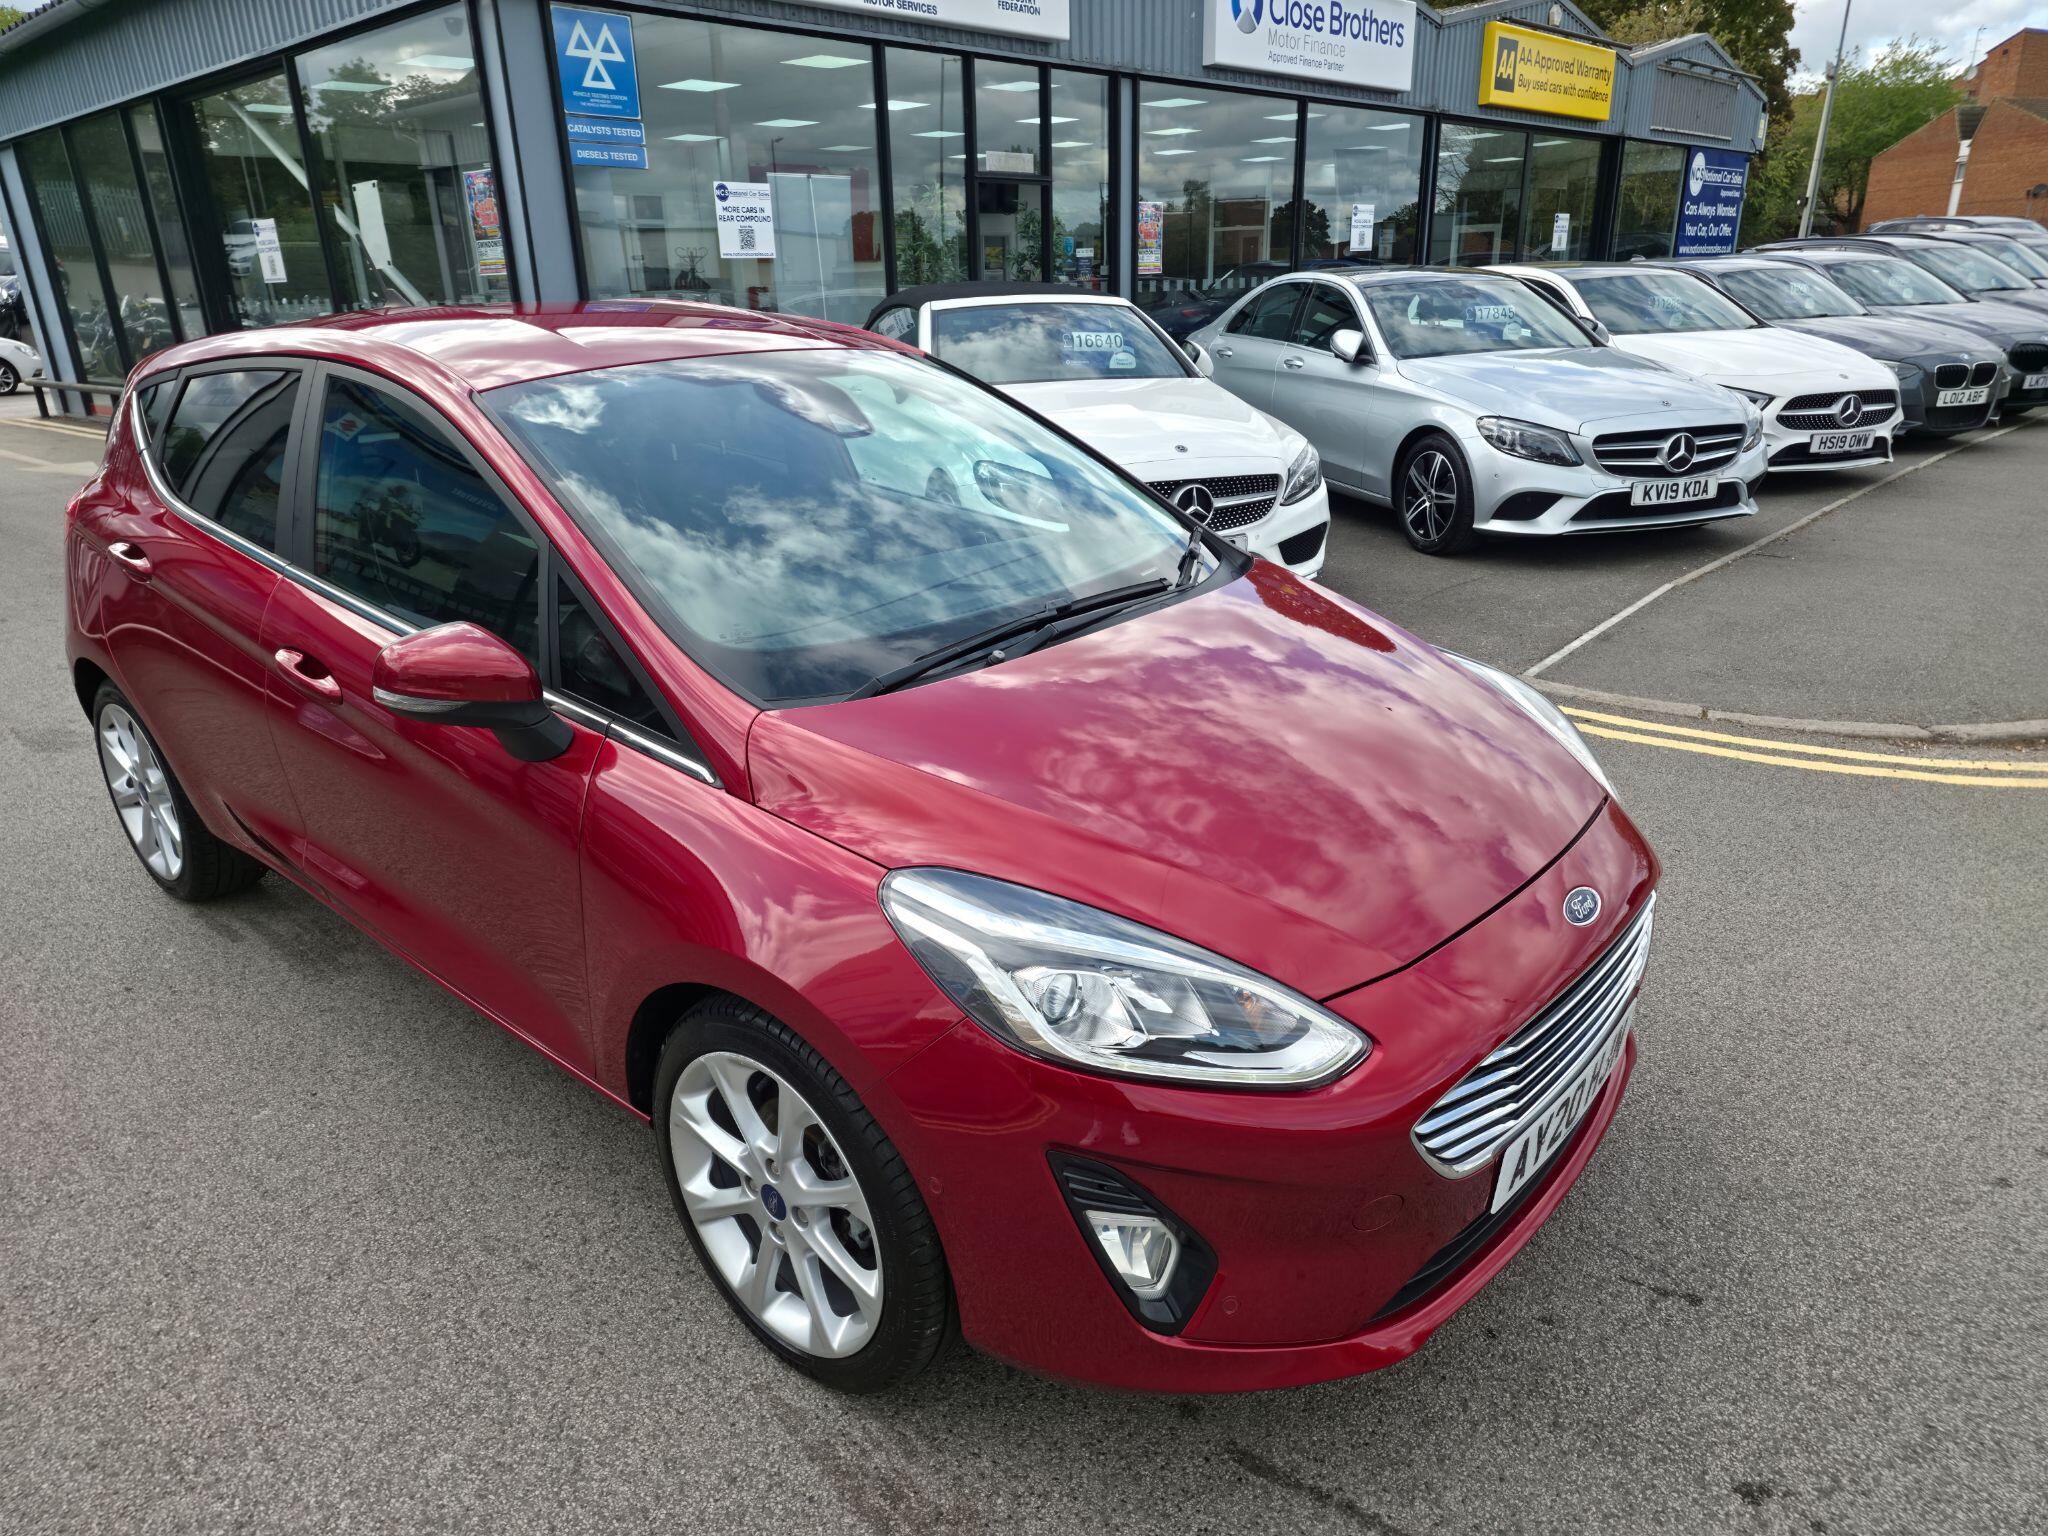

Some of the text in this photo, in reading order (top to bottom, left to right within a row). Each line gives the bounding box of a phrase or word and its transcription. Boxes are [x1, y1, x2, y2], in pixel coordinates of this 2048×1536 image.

[896, 0, 938, 15] SERVICES
[997, 0, 1041, 16] FEDERATION
[1269, 0, 1405, 48] Close Brothers
[1267, 28, 1346, 58] Motor Finance
[1267, 50, 1345, 72] Approved Finance Partner
[1496, 48, 1516, 80] AA
[1518, 47, 1612, 87] AA Approved Warranty
[1518, 74, 1609, 103] Buy used cars with confidence
[568, 123, 641, 138] CATALYSTS TESTED
[577, 149, 638, 162] DIESELS TESTED
[1690, 167, 1704, 181] NCS
[1704, 168, 1743, 185] National Car Sales
[722, 205, 740, 214] MORE
[740, 206, 758, 214] CARS
[1685, 201, 1737, 219] Cars Always Wanted.
[718, 214, 772, 223] REAR COMPOUND
[1685, 222, 1697, 237] Your
[1697, 223, 1708, 239] Car,
[1708, 223, 1719, 237] Our
[1679, 243, 1732, 255] www.nationalcarsales.co.uk
[1942, 390, 1985, 405] LO12 ABF
[1818, 435, 1848, 450] HS19
[1642, 479, 1709, 502] KV19 KDA
[1570, 894, 1595, 919] Ford
[1508, 1078, 1587, 1192] AY20
